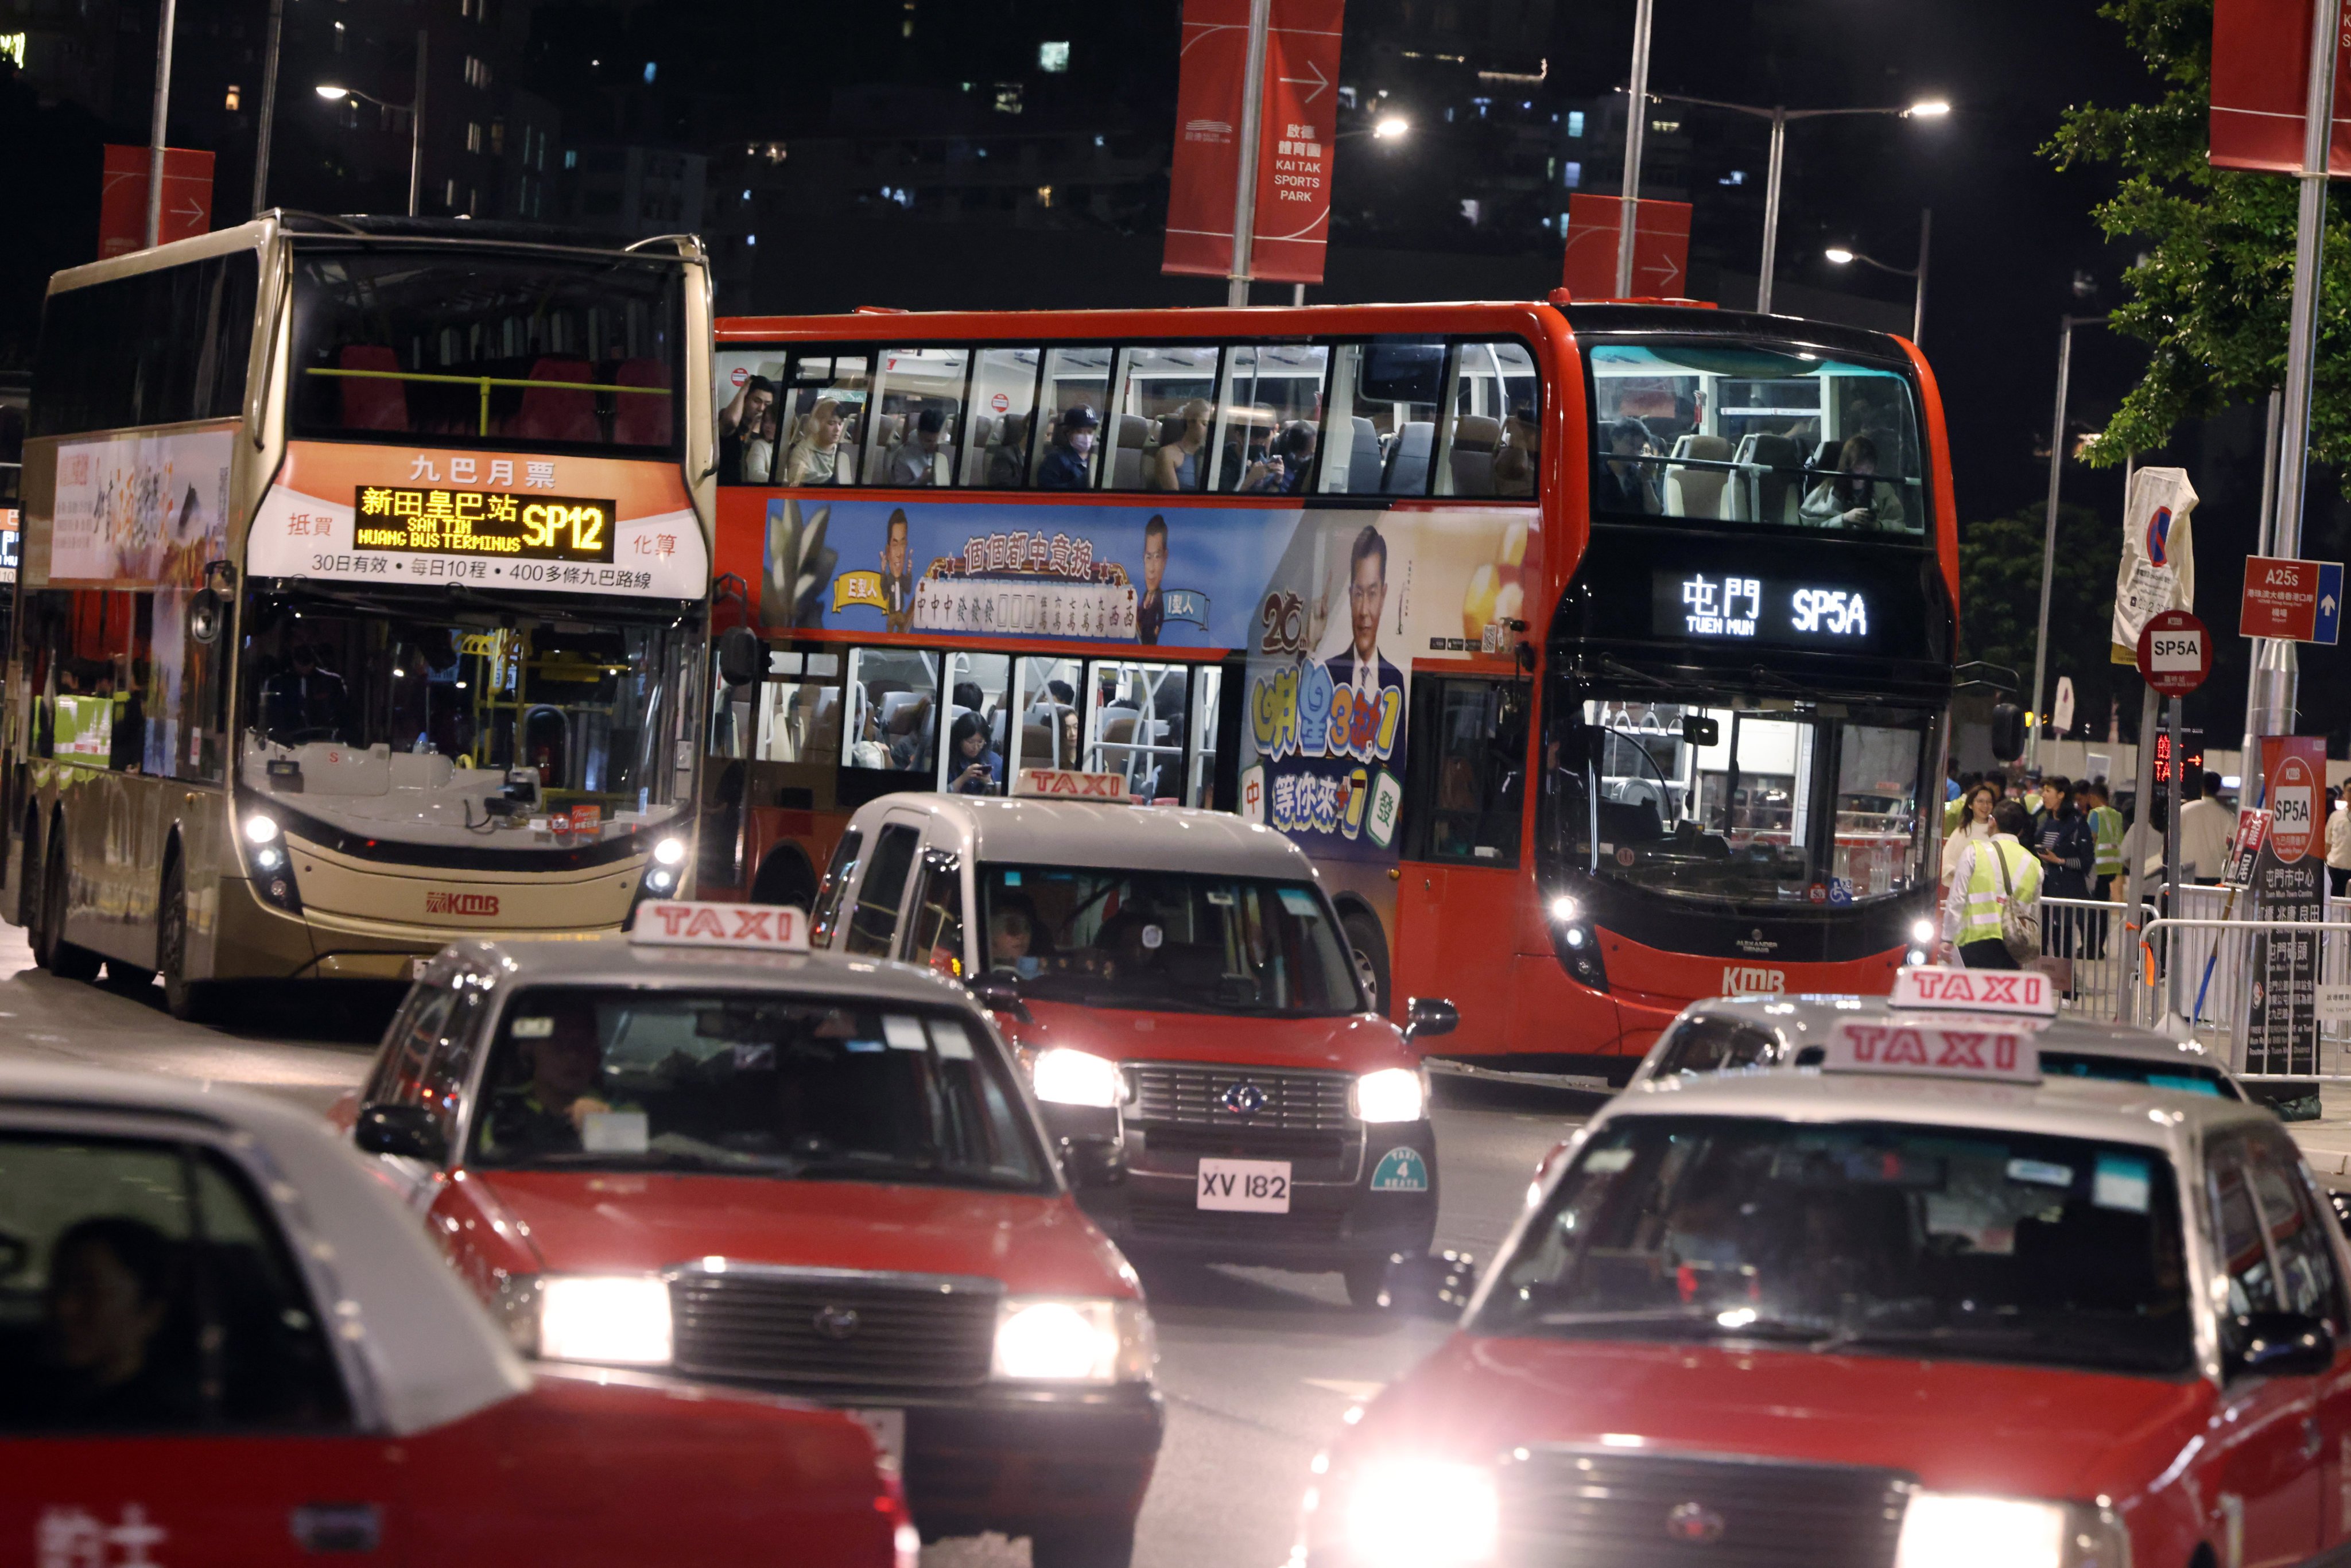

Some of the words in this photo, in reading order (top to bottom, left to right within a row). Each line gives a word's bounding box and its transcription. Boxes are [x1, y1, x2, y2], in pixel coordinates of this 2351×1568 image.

[1276, 160, 1295, 170] KAI
[1298, 161, 1321, 173] TAK
[1274, 174, 1320, 188] SPORTS
[1280, 190, 1312, 202] PARK
[410, 456, 556, 488] 九巴月票
[362, 488, 518, 522] 新田皇巴站
[288, 513, 333, 537] 抵買
[408, 518, 437, 532] SAN
[522, 504, 603, 550] SP12
[358, 530, 407, 546] HUANG
[410, 533, 440, 548] BUS
[441, 534, 521, 552] TERMINUS
[634, 533, 677, 557] 化算
[312, 554, 387, 573] 30日有效
[411, 559, 487, 579] 每日10程
[510, 565, 651, 590] 400多條九巴路線
[2265, 569, 2299, 587] A25s
[848, 578, 878, 598] E型人
[1683, 574, 1760, 619] 屯門
[1168, 595, 1193, 615] I型人
[1793, 589, 1867, 635] SP5A
[1686, 616, 1722, 633] TUEN
[1727, 617, 1754, 635] MUN
[2154, 641, 2198, 655] SP5A
[1031, 771, 1119, 796] TAXI
[2275, 801, 2309, 821] SP5A
[2266, 868, 2314, 888] 屯門市中心
[447, 894, 499, 917] KMB
[655, 906, 793, 942] TAXI
[1722, 967, 1785, 996] KMB
[1913, 972, 2041, 1005] TAXI
[1845, 1024, 2018, 1070] TAXI
[1396, 1161, 1409, 1178] 4
[1202, 1173, 1236, 1198] XV
[1244, 1174, 1286, 1200] 182
